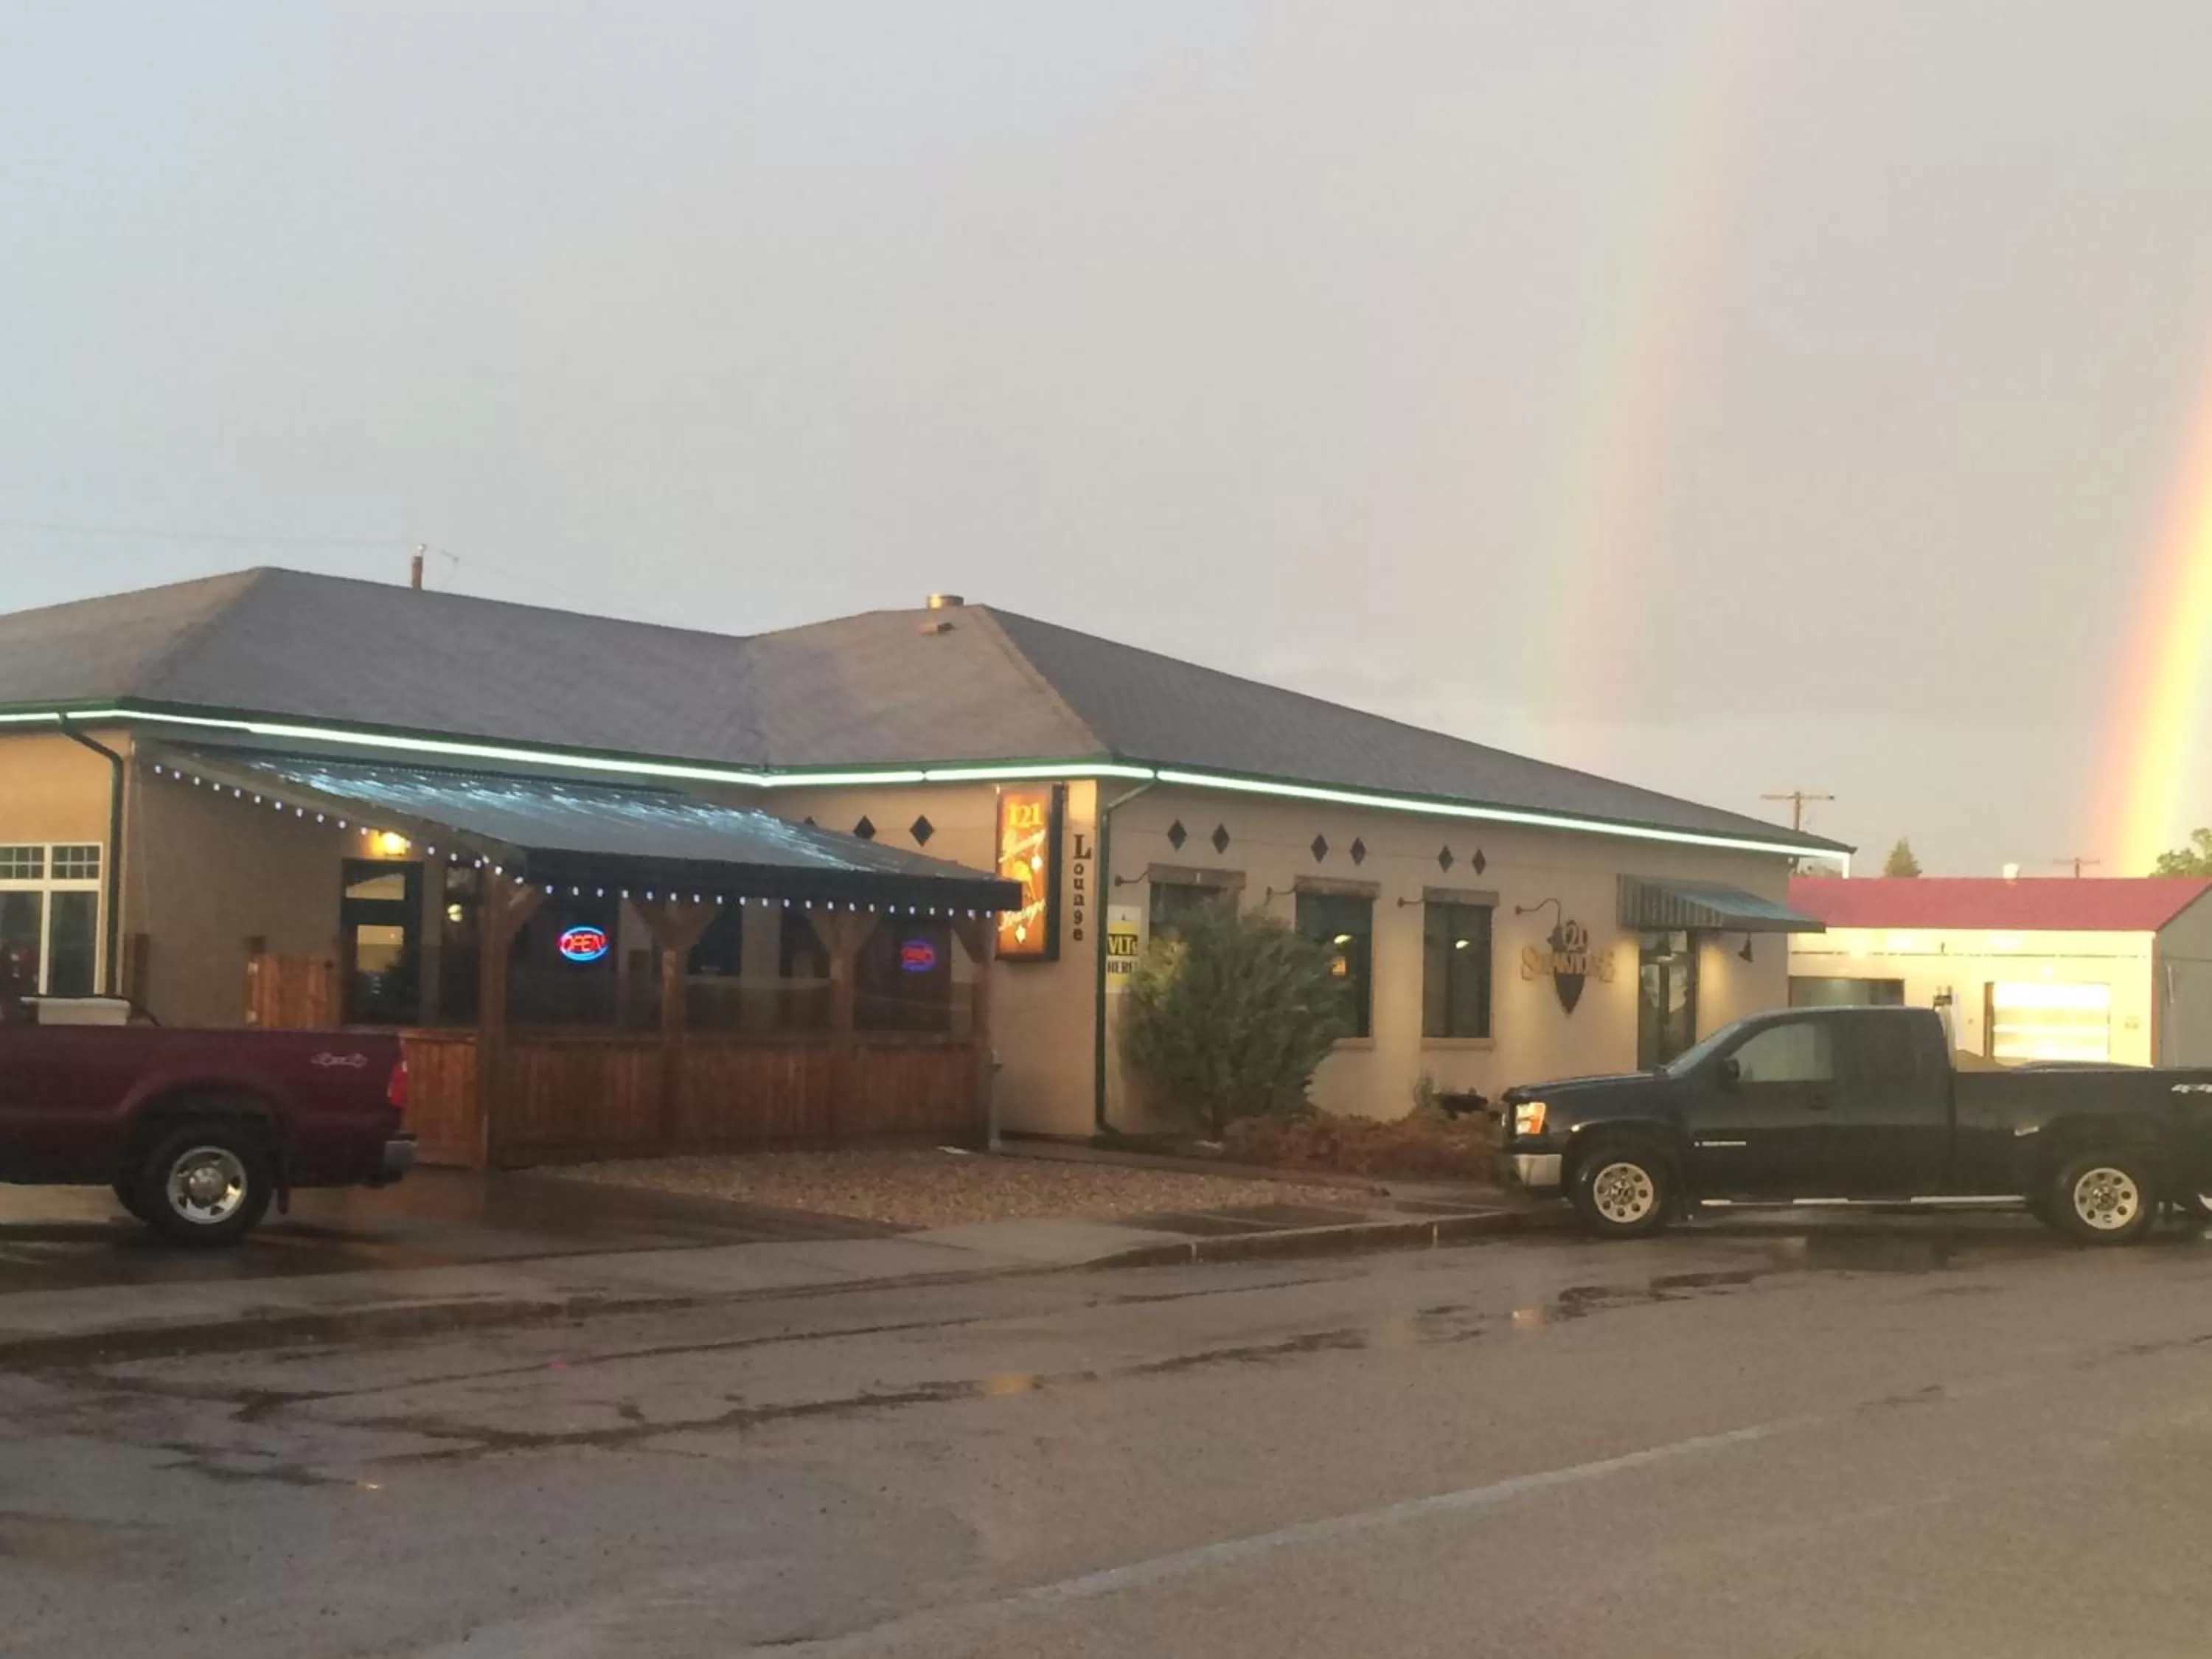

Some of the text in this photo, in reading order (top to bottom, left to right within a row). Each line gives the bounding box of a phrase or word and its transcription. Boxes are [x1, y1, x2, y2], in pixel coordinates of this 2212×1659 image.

[1009, 803, 1043, 828] 121
[1073, 833, 1093, 941] Lounge
[560, 933, 606, 952] OPEN
